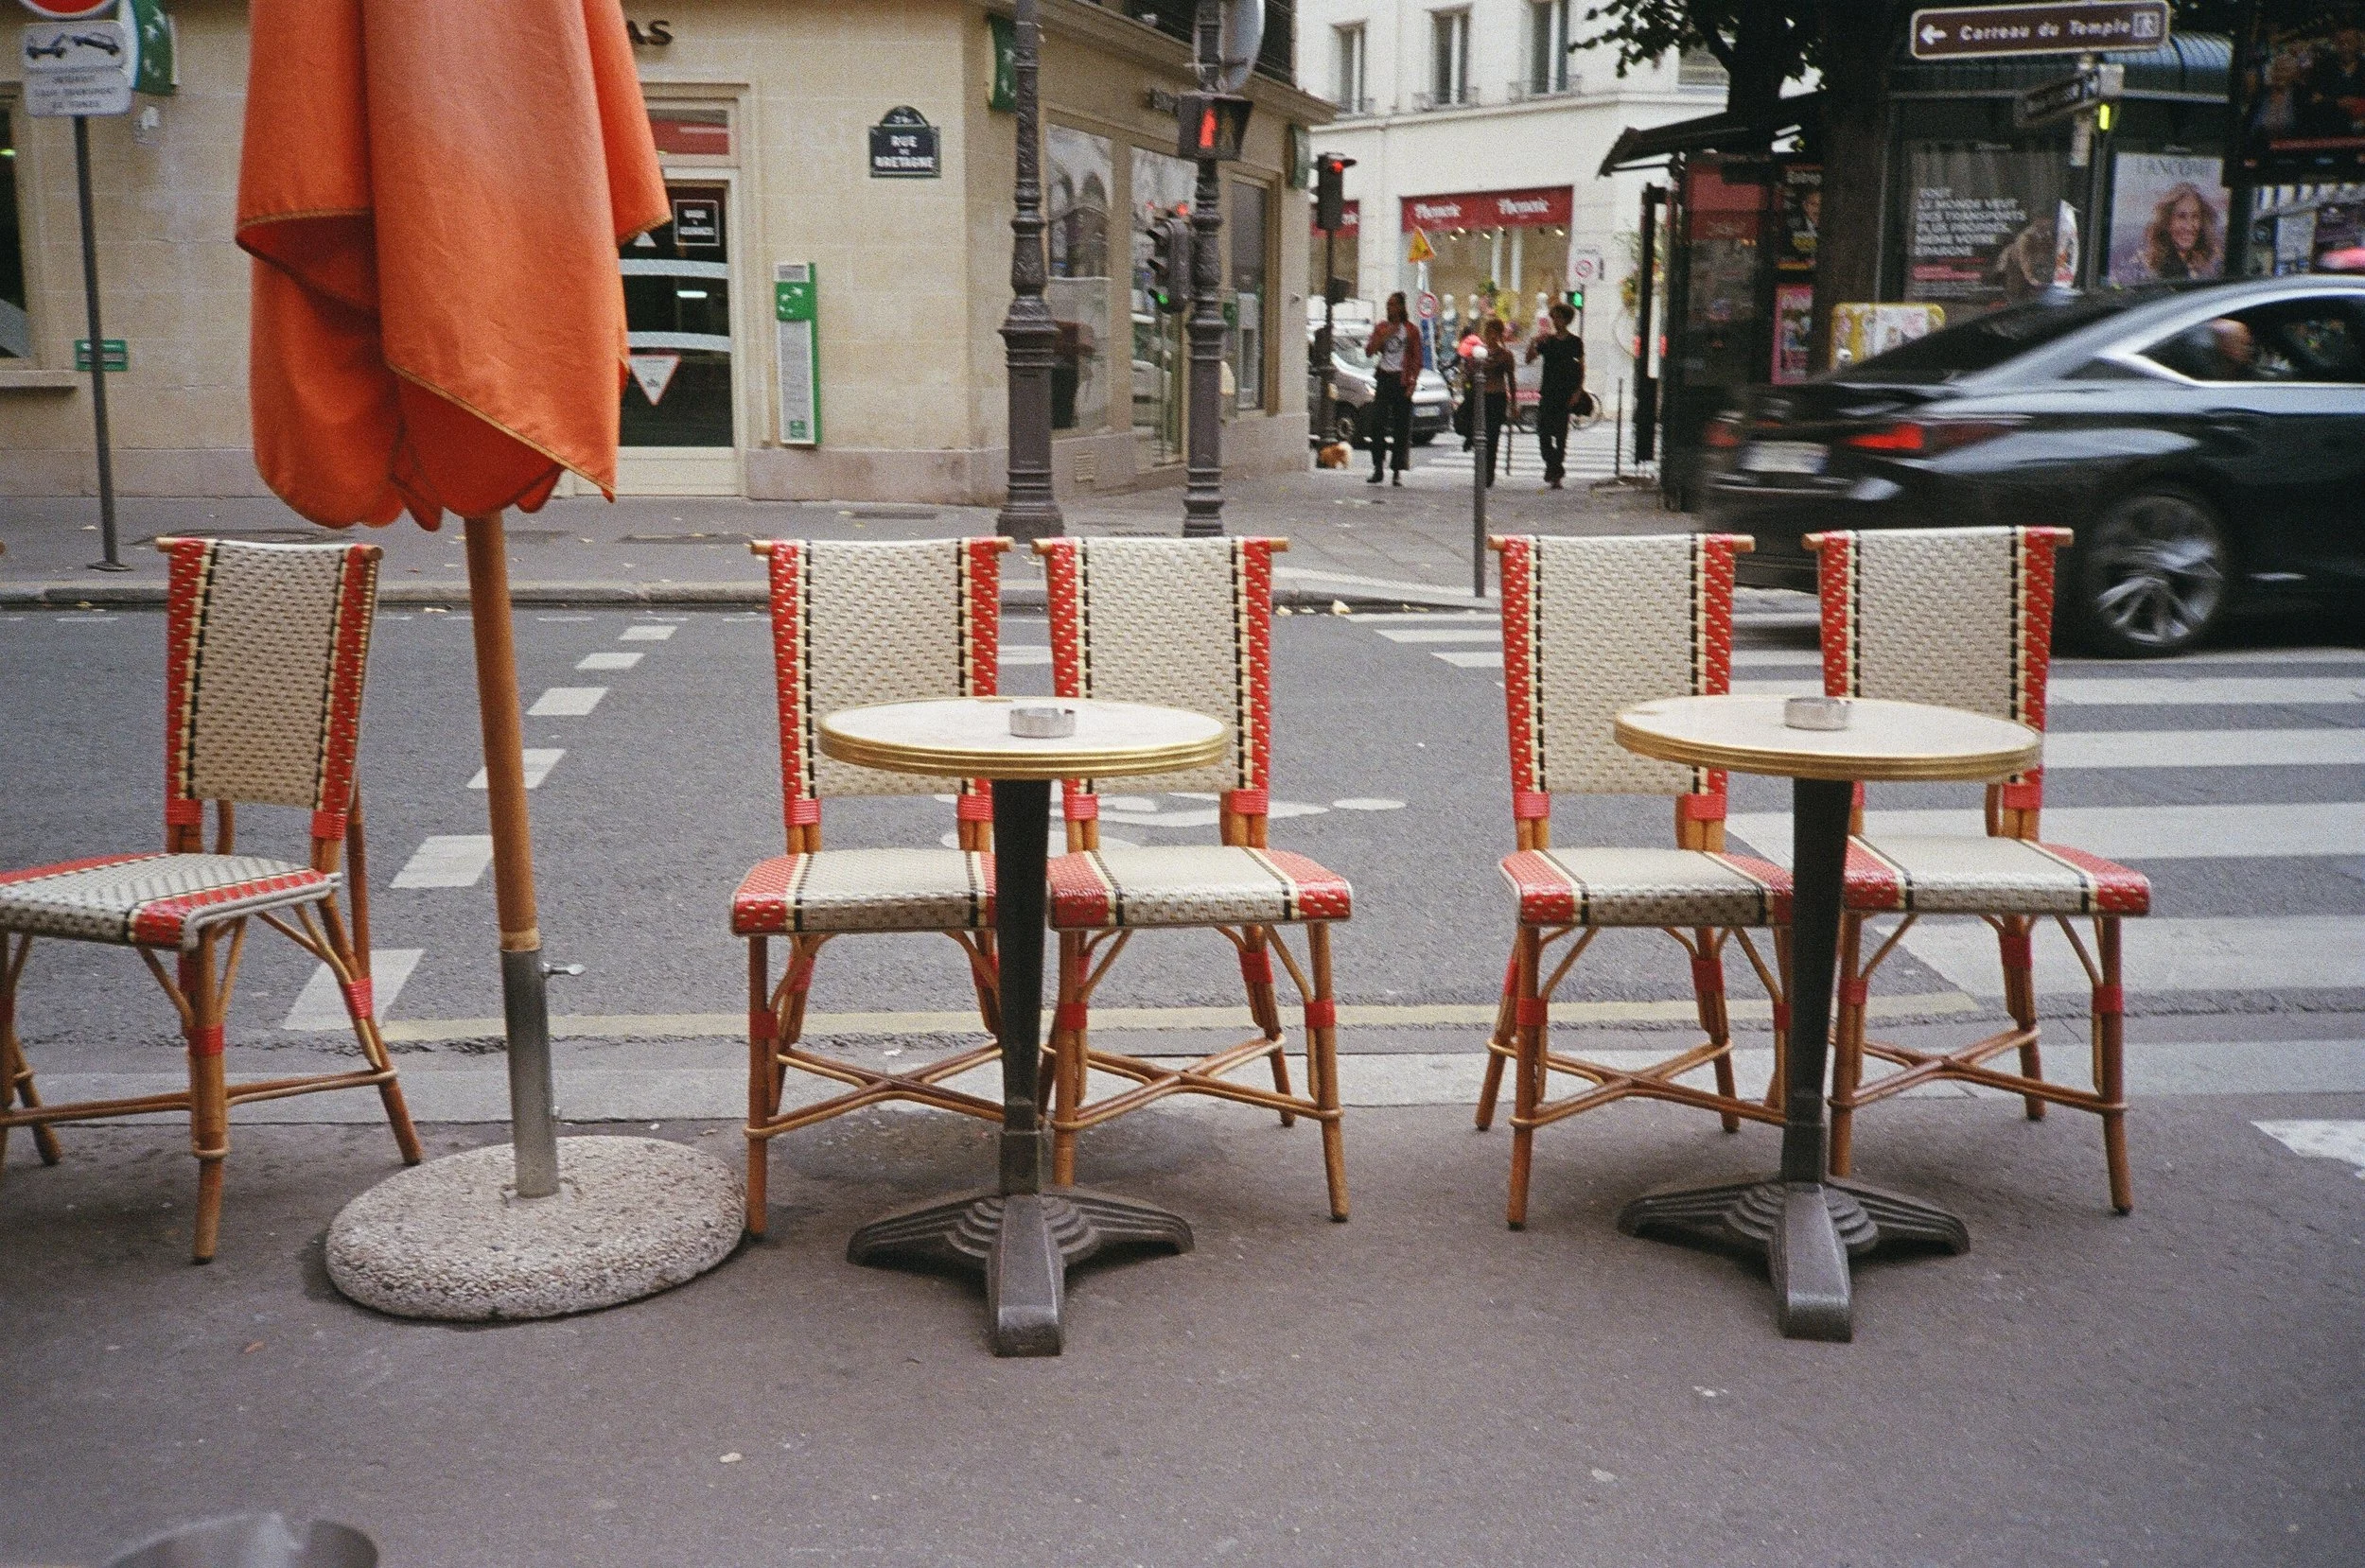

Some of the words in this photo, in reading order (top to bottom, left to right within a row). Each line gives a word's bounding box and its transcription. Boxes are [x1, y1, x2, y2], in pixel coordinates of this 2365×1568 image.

[1959, 25, 2031, 42] Carreau
[2037, 22, 2059, 38] du
[2069, 18, 2129, 37] Temple
[890, 135, 918, 148] RUE
[875, 156, 935, 168] BRETAGNE
[1936, 199, 1983, 209] MONDE
[1945, 209, 2027, 221] TRANSPORTS
